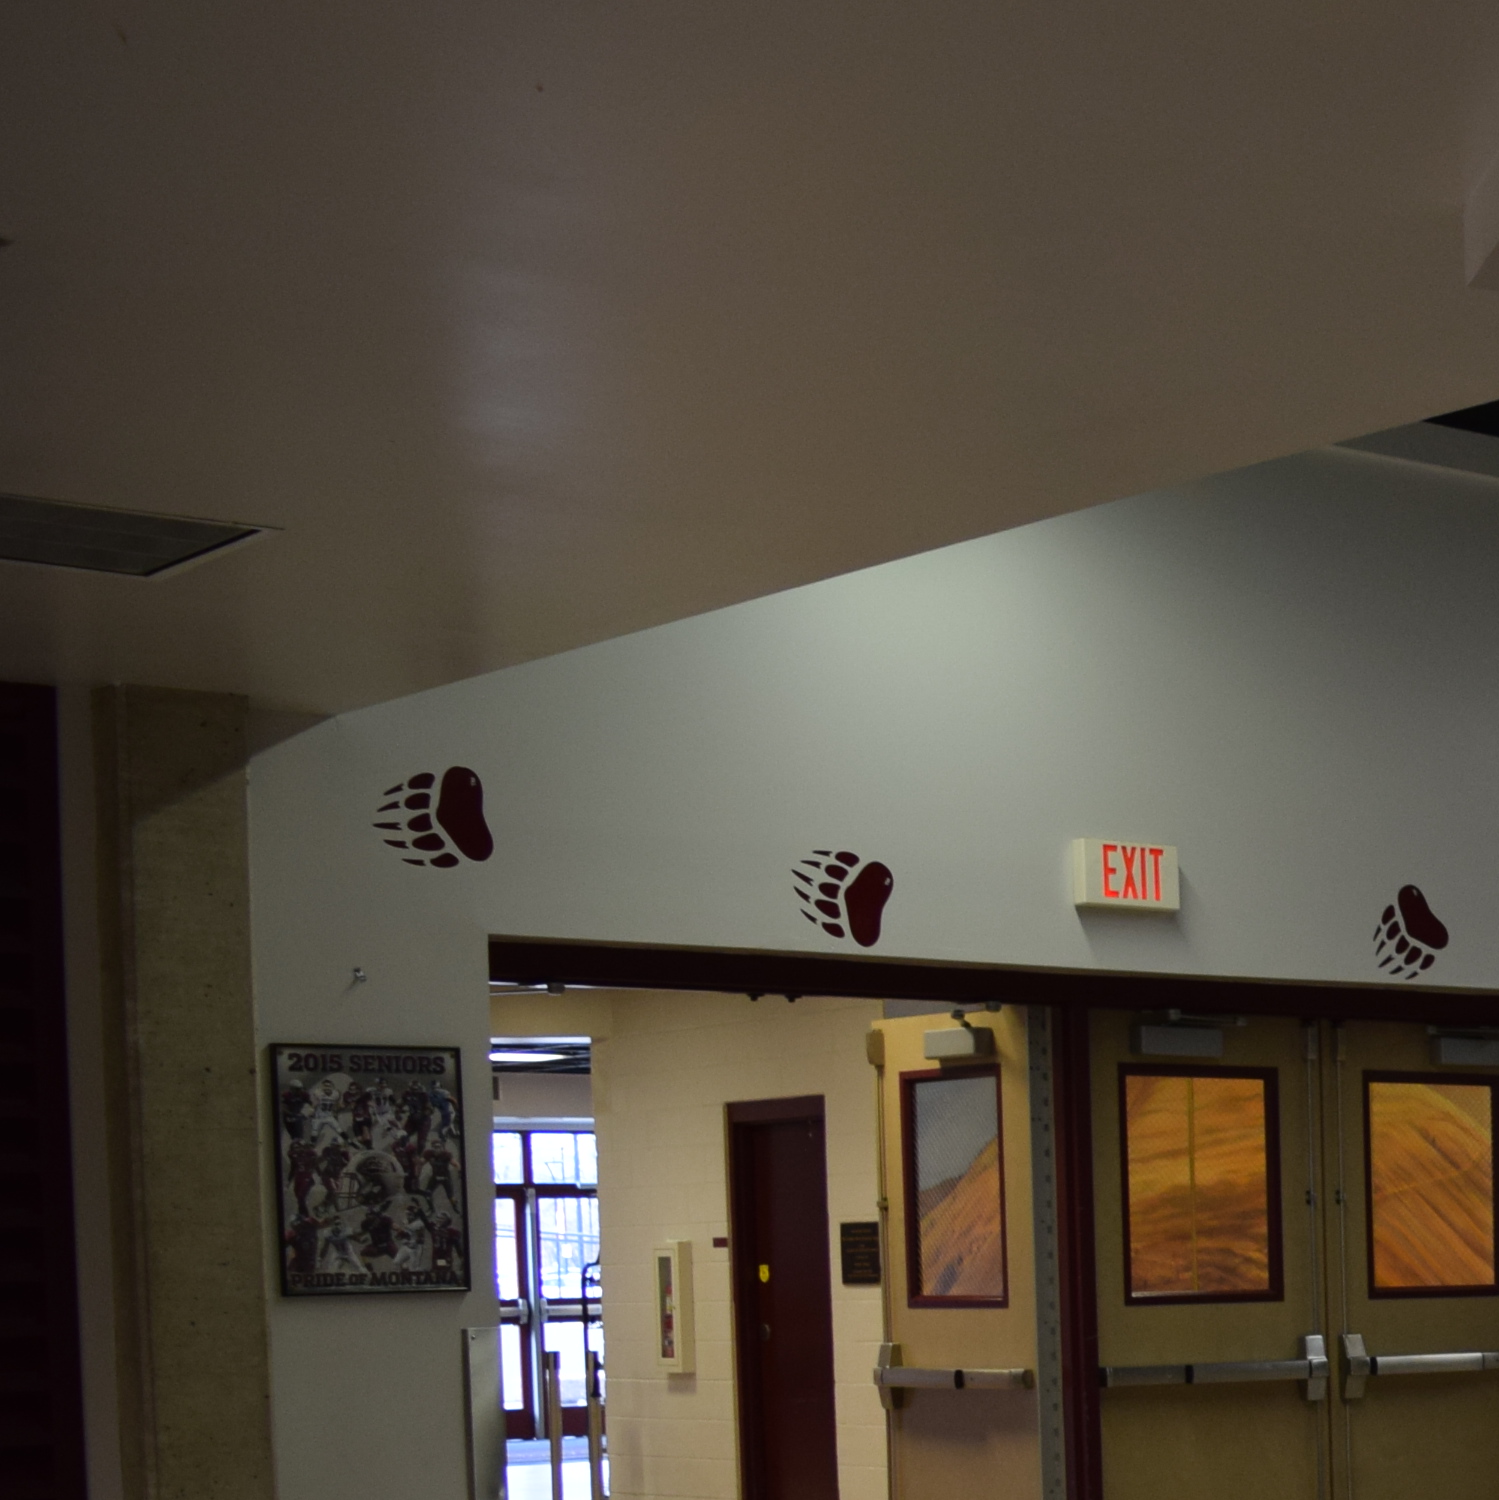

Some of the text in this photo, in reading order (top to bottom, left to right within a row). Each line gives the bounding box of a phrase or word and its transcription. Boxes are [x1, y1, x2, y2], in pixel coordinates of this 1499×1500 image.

[1103, 844, 1163, 901] EXIT
[287, 1053, 446, 1075] 2015 SENIORS
[290, 1270, 460, 1288] PRIDE OF MONTANA
